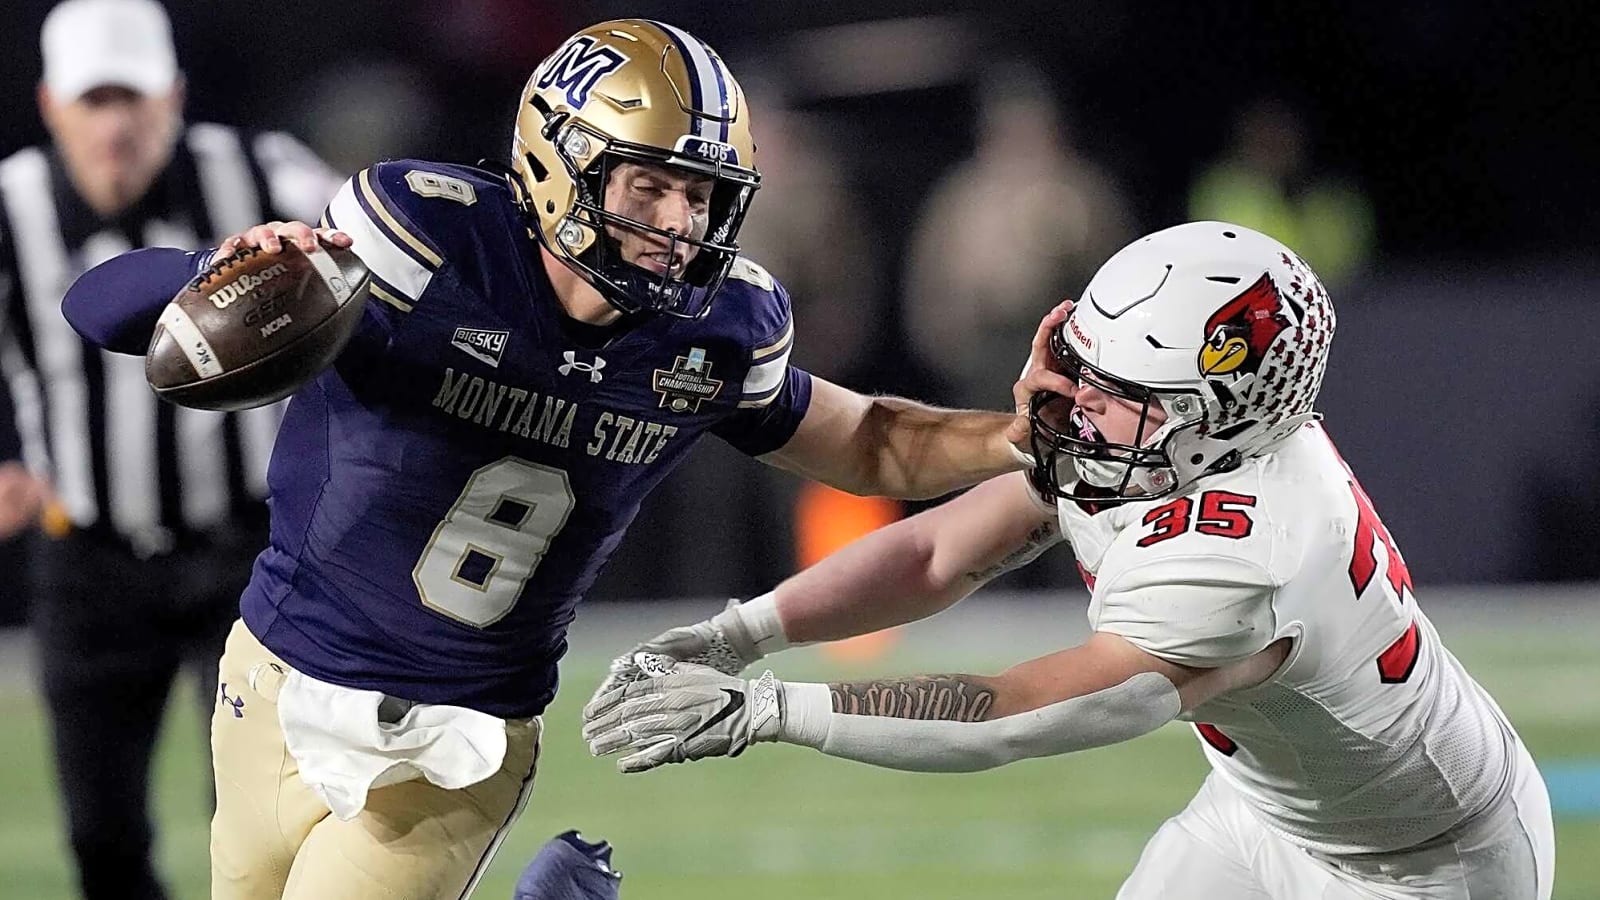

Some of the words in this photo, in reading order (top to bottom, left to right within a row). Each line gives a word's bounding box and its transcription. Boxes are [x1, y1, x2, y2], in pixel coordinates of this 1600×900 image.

[535, 35, 631, 114] M
[698, 141, 728, 162] 406
[404, 169, 478, 207] 8
[207, 262, 288, 309] Wilson
[260, 313, 293, 338] NCAA
[658, 377, 715, 395] CHAMPIONSHIP
[432, 367, 578, 449] MONTANA
[586, 411, 678, 464] STATE
[1136, 489, 1257, 548] 35
[411, 454, 576, 631] 8
